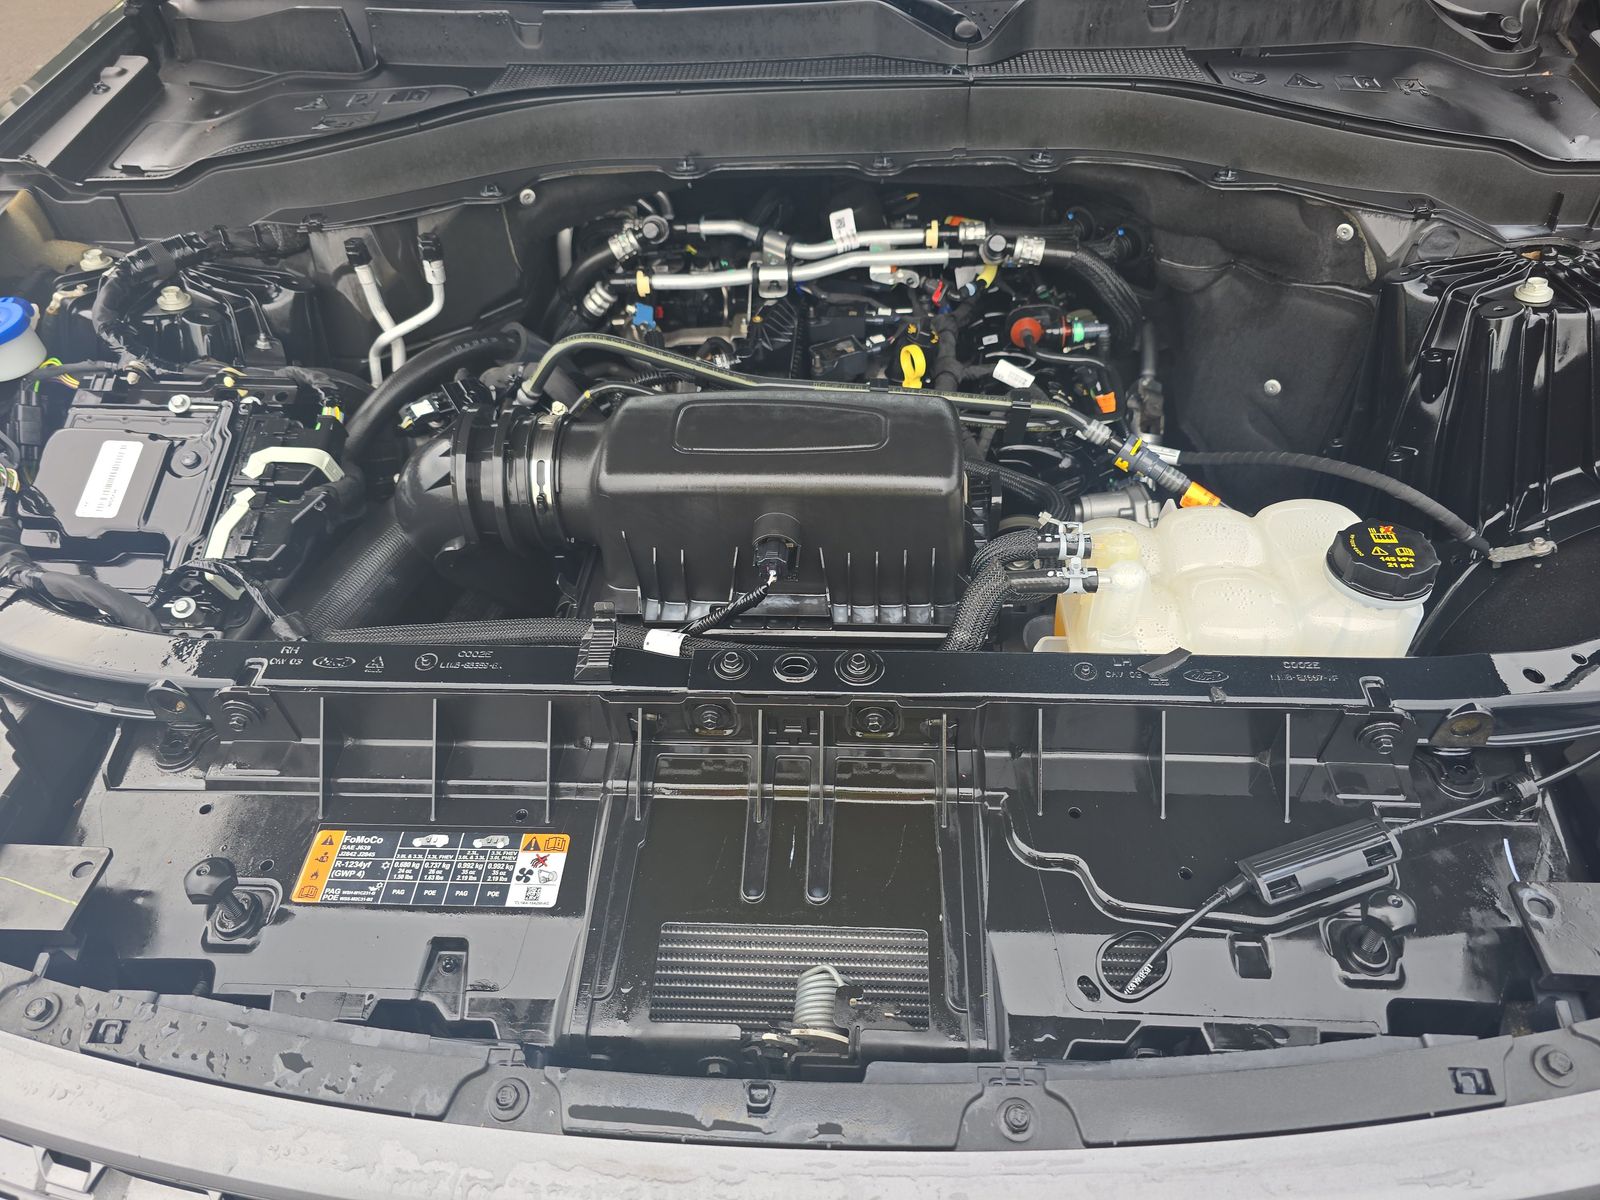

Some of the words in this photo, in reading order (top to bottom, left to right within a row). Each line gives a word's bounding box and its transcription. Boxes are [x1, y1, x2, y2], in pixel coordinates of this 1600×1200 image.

[280, 645, 300, 654] RH
[344, 835, 384, 844] FoMoCo
[335, 861, 372, 869] R-1234yf
[442, 862, 451, 870] kg
[505, 863, 514, 871] kg
[331, 870, 356, 878] (GWP
[356, 870, 365, 878] 4)
